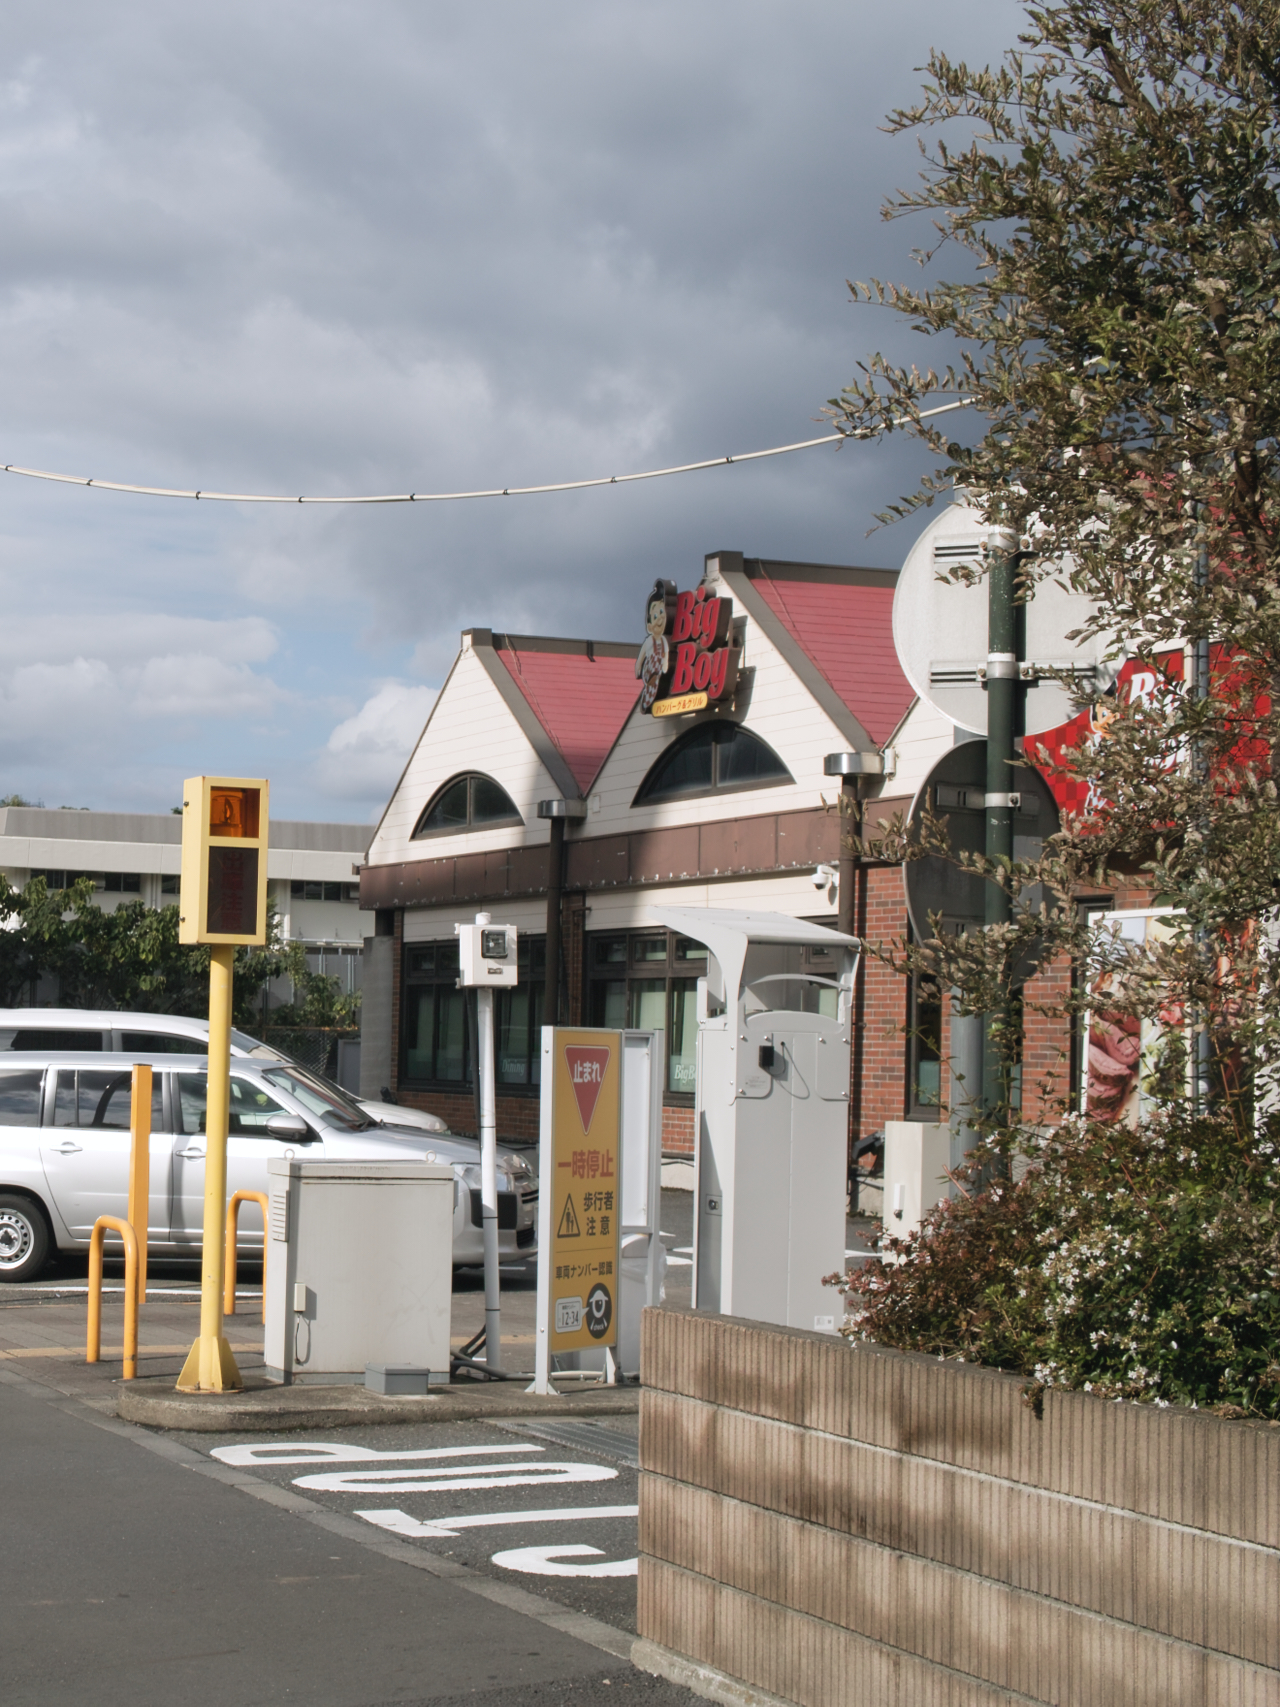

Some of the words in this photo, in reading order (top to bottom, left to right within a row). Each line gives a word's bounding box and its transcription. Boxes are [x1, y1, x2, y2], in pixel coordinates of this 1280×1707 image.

[671, 585, 721, 649] Big
[670, 641, 730, 699] Boy
[501, 1058, 525, 1077] Dining
[573, 1060, 601, 1083] 止まれ
[558, 1149, 614, 1180] 一時停止
[583, 1191, 614, 1212] 歩行者
[555, 1261, 613, 1280] 車両ナンバー認識
